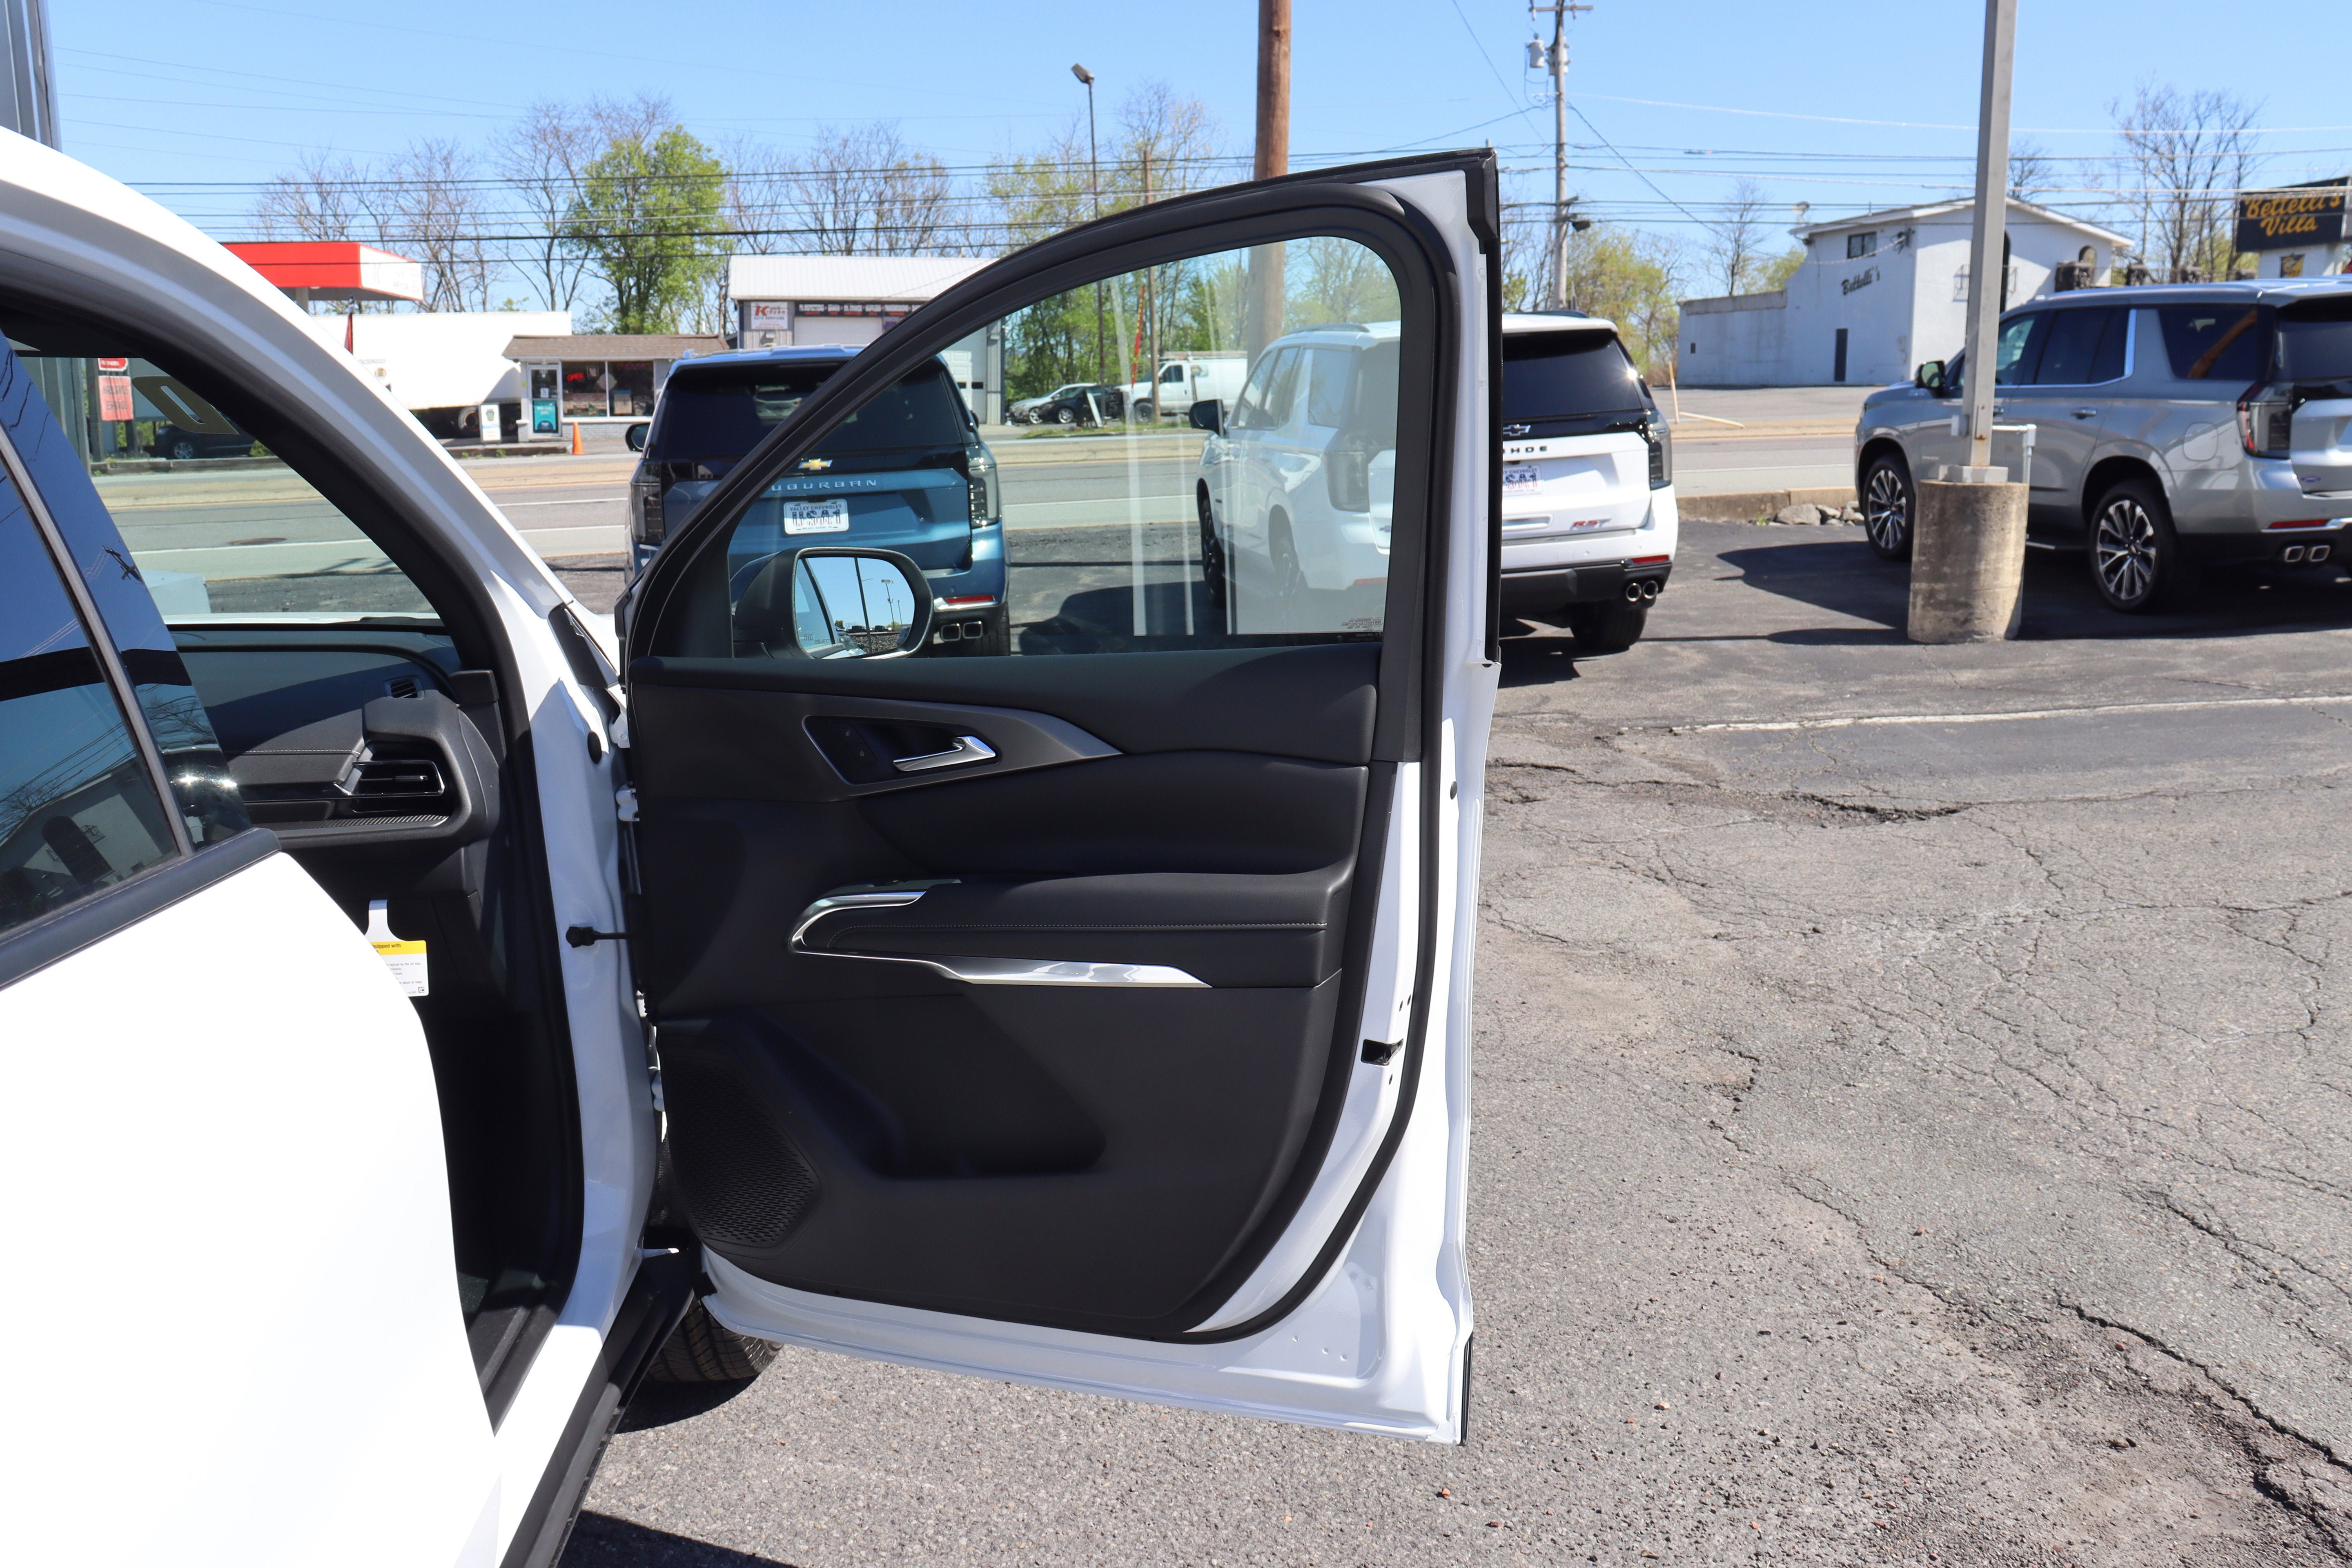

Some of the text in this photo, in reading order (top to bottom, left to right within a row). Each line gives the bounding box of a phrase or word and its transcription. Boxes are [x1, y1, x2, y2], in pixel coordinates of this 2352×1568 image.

[2245, 182, 2341, 219] Bettellis
[2259, 216, 2319, 237] Villa
[567, 372, 584, 382] OPEN
[1503, 445, 1548, 454] HOE
[771, 479, 877, 491] UBURBAN
[1503, 472, 1537, 489] SA1
[792, 509, 841, 526] USA1
[1572, 517, 1612, 527] RST
